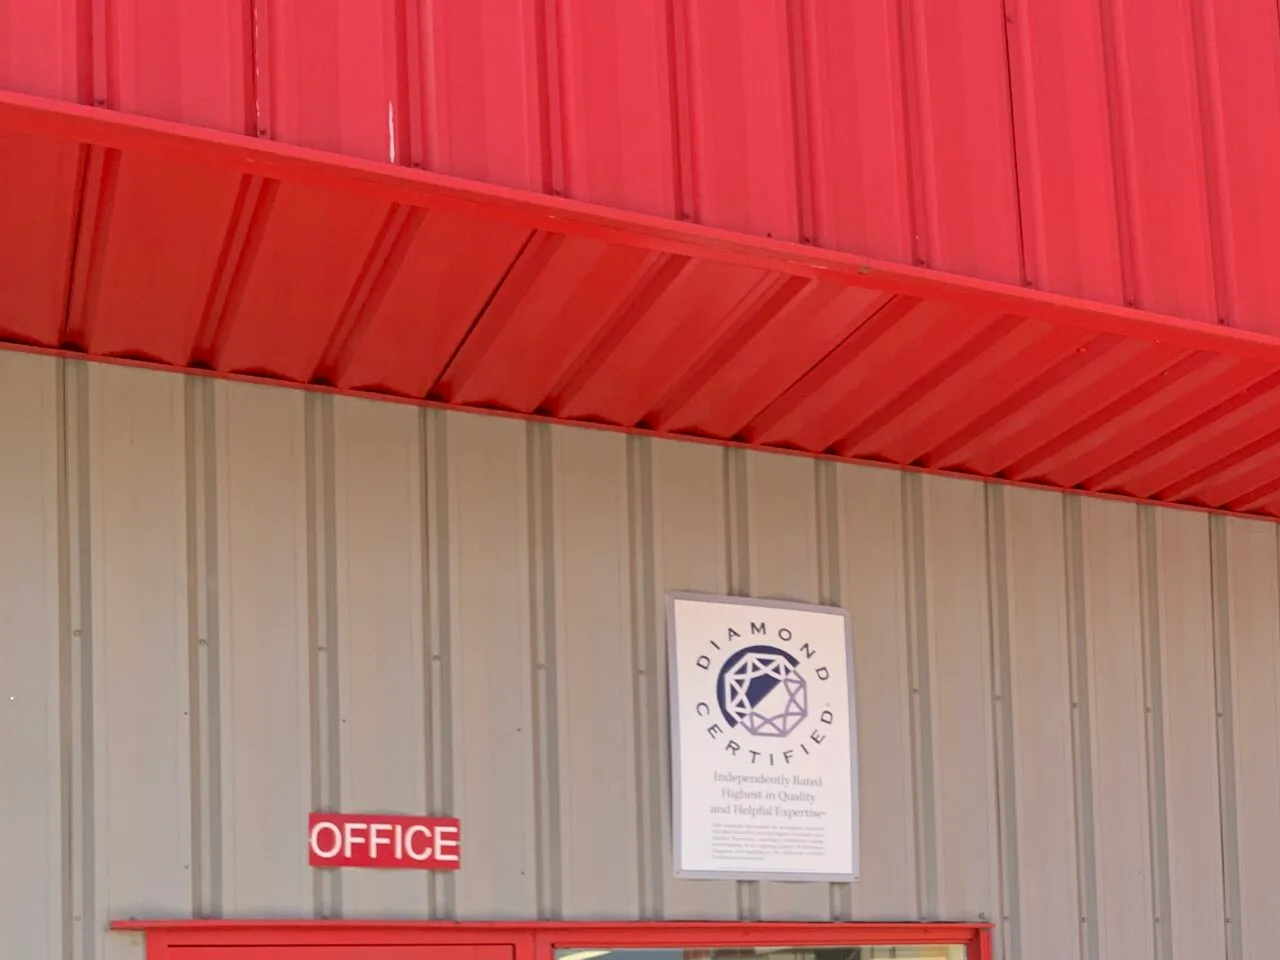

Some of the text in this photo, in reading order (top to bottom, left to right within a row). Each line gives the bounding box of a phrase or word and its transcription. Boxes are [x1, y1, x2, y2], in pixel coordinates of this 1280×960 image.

[696, 621, 829, 681] DIAMOND
[696, 702, 834, 766] CERTIFIED
[713, 771, 823, 787] Independently Rated
[721, 787, 816, 804] Highest in Quality
[710, 804, 731, 814] and
[733, 804, 772, 818] Helpful
[311, 821, 459, 861] OFFICE
